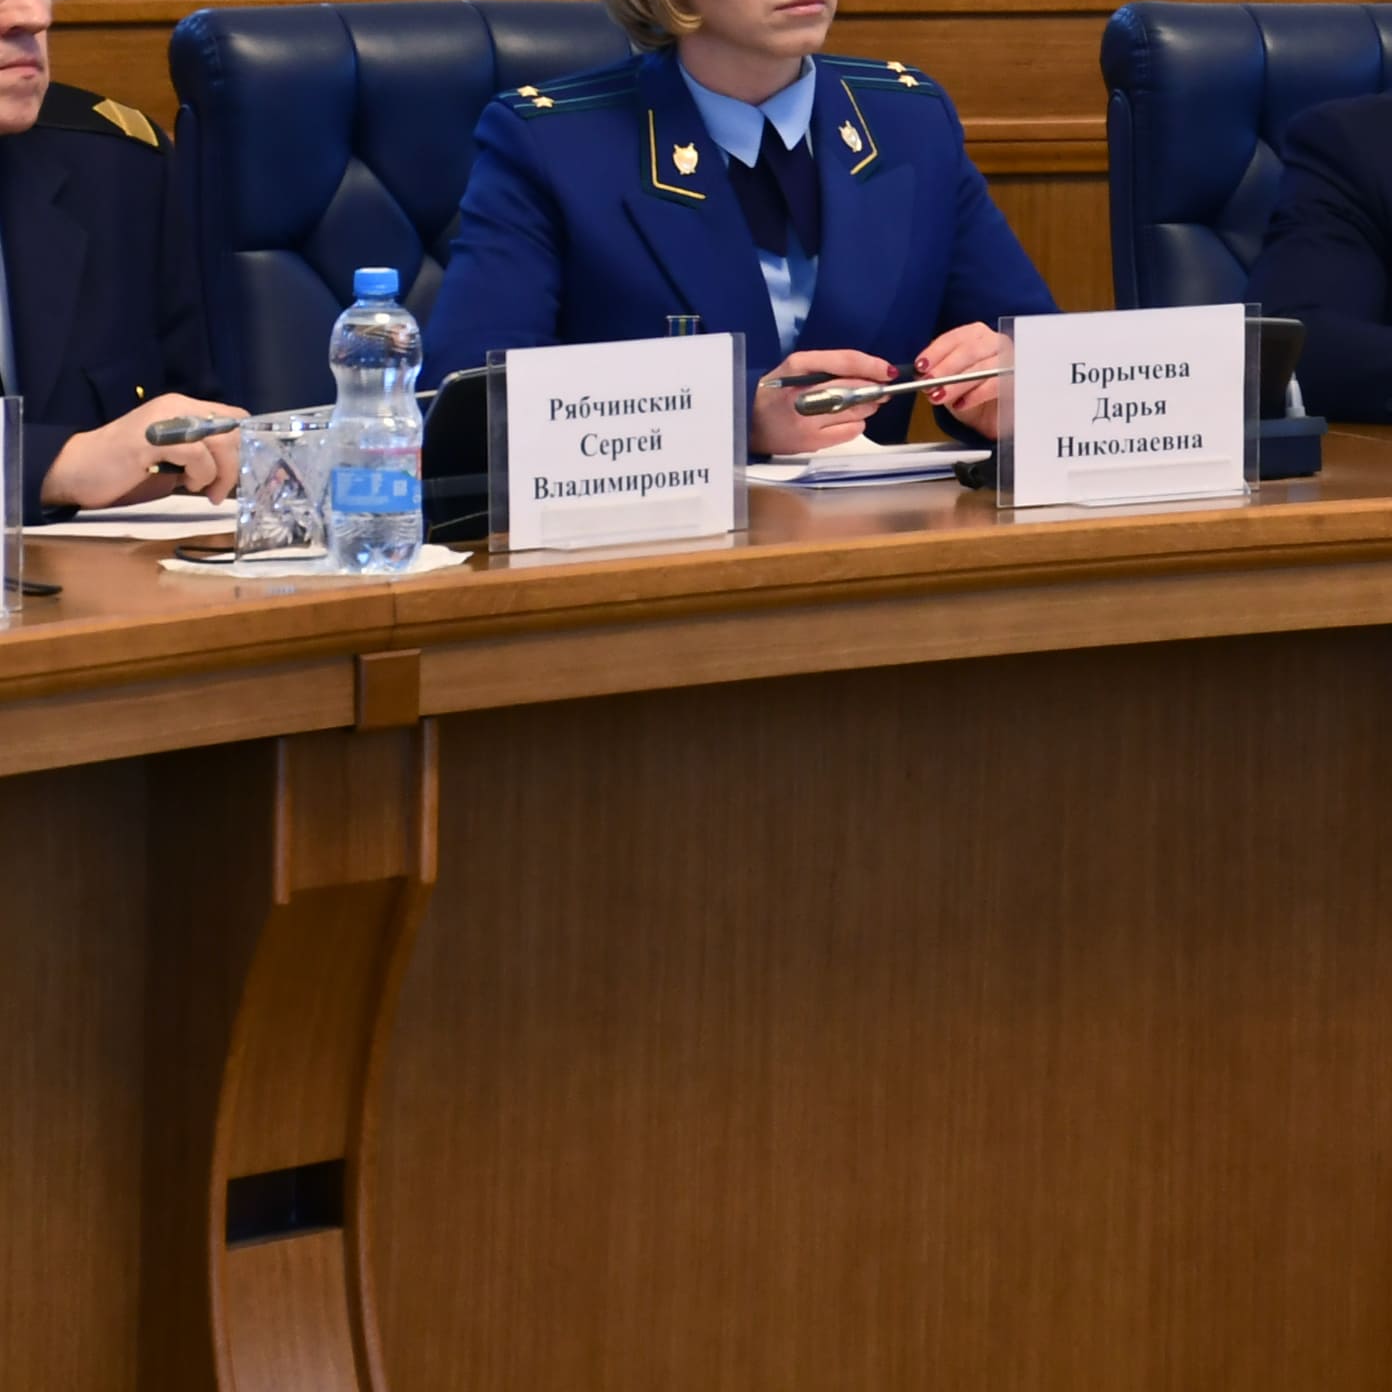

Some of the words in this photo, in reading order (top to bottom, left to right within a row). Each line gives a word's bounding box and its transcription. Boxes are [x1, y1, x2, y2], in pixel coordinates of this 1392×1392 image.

[1070, 361, 1191, 390] Борычева
[549, 387, 692, 422] Рябчинский
[1091, 396, 1167, 425] Дарья
[579, 427, 663, 462] Сергей
[1056, 433, 1204, 459] Николаевна
[533, 467, 710, 501] Владимирович
